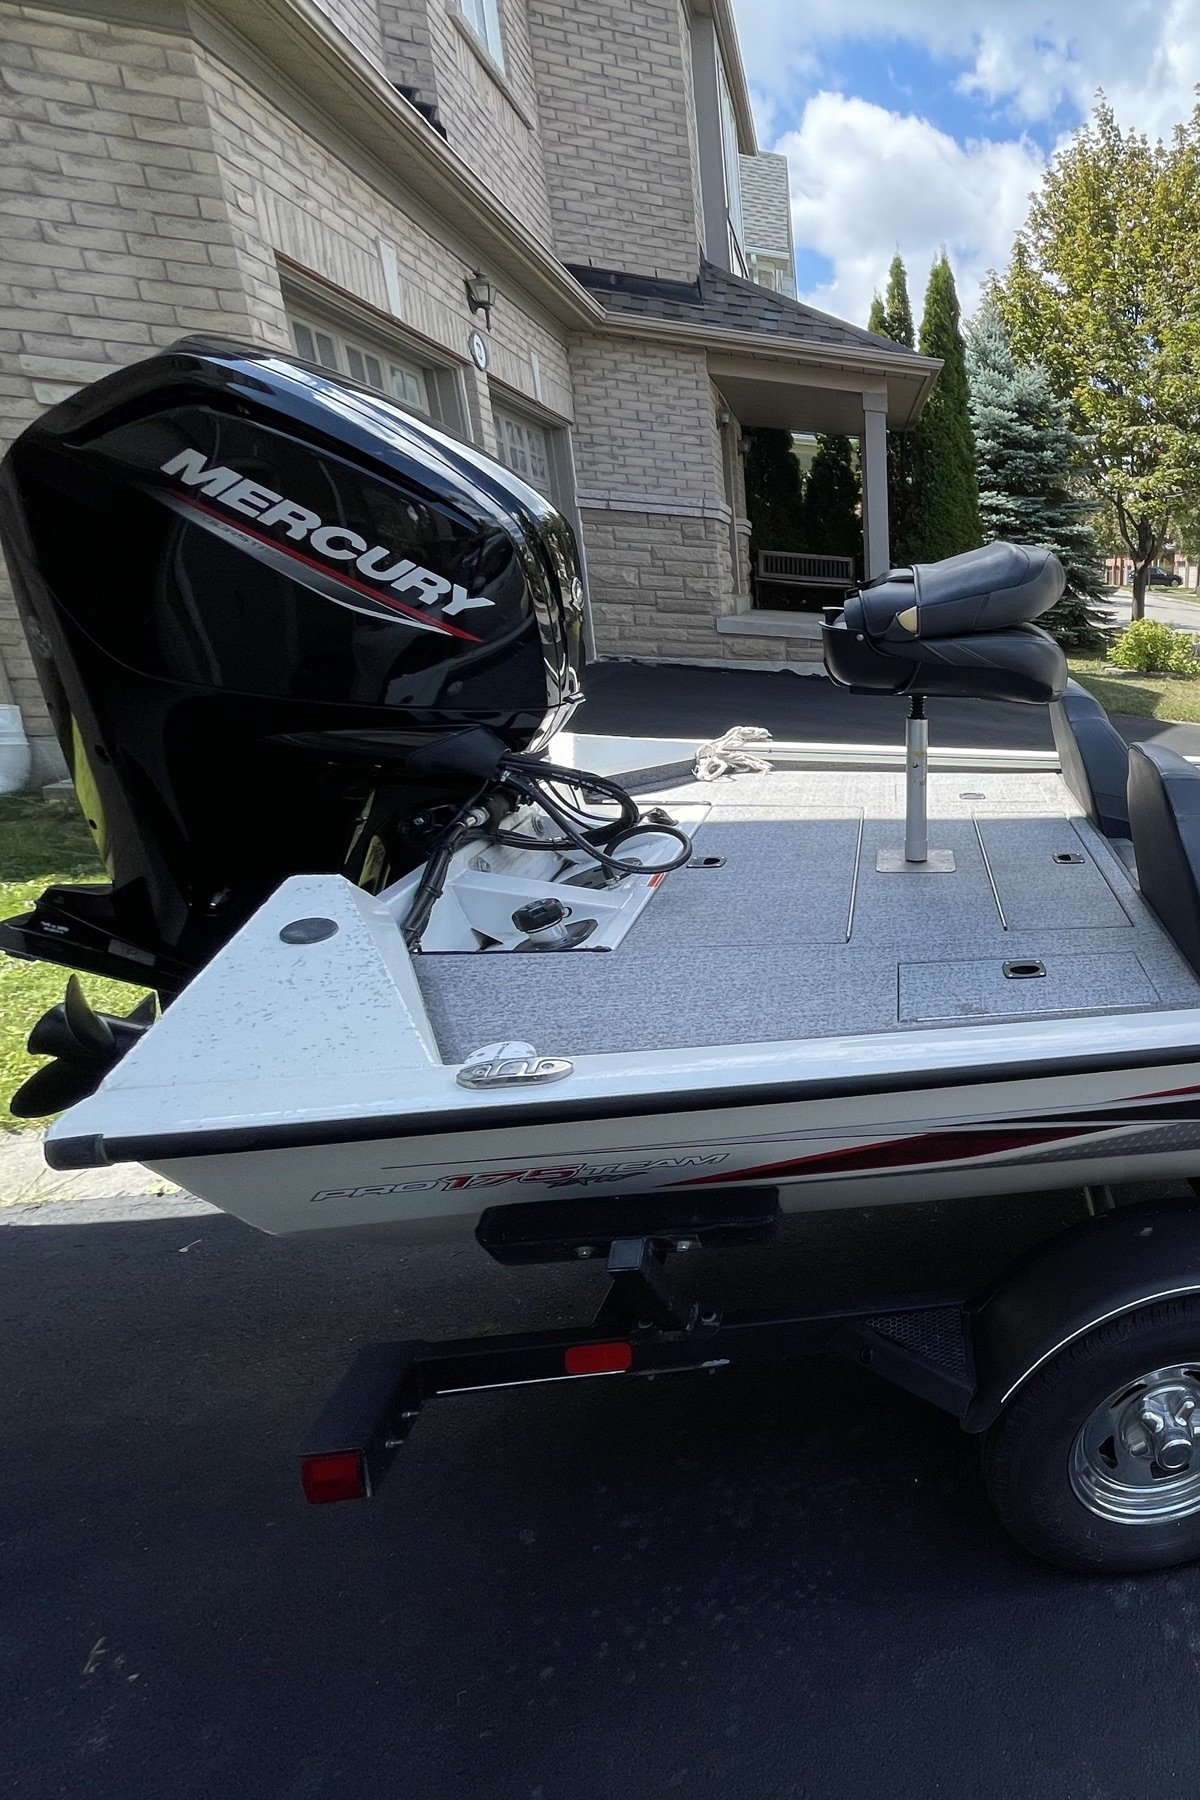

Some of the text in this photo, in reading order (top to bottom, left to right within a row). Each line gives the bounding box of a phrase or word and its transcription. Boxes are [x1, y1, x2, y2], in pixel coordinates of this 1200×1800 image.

[160, 448, 495, 615] MERCURY
[310, 1153, 731, 1202] PRO 175 TEAM
